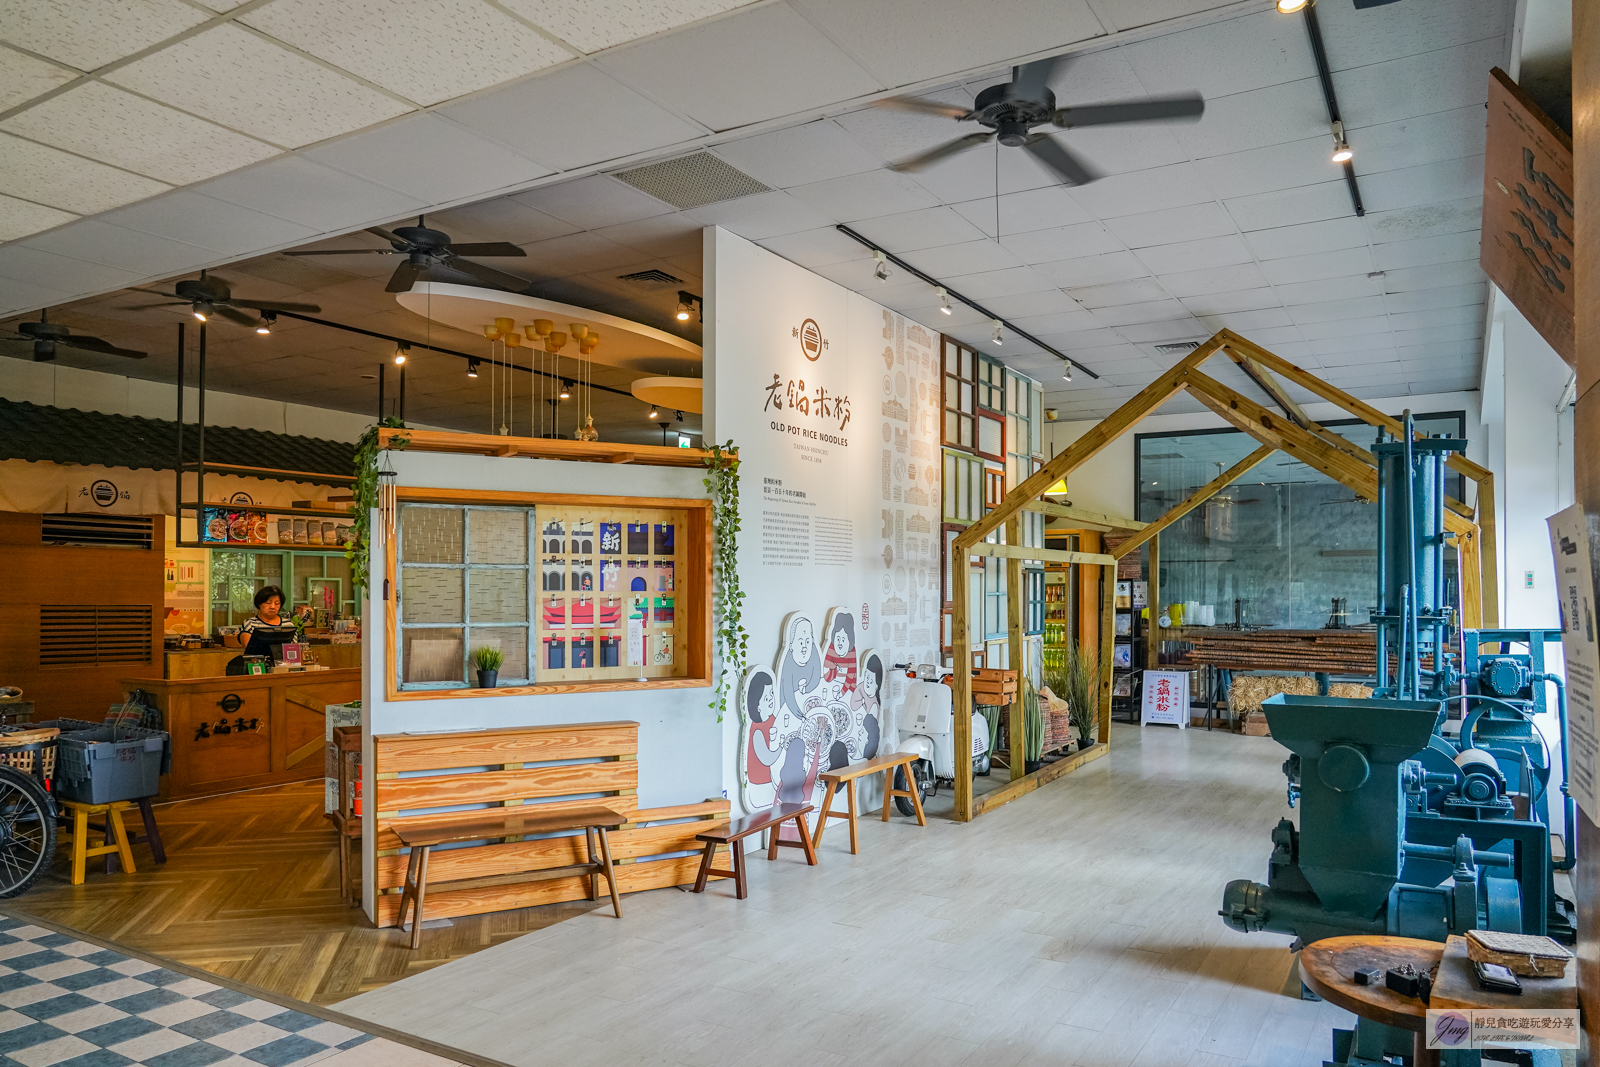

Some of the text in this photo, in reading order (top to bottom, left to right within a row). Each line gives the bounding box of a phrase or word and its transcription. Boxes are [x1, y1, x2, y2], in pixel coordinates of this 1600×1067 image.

[763, 373, 851, 432] 老鍋米粉
[770, 421, 848, 447] OLD POT RICE NOODLES
[800, 454, 813, 462] SINCE
[601, 531, 621, 551] 新
[1155, 678, 1171, 712] 老鍋米粉
